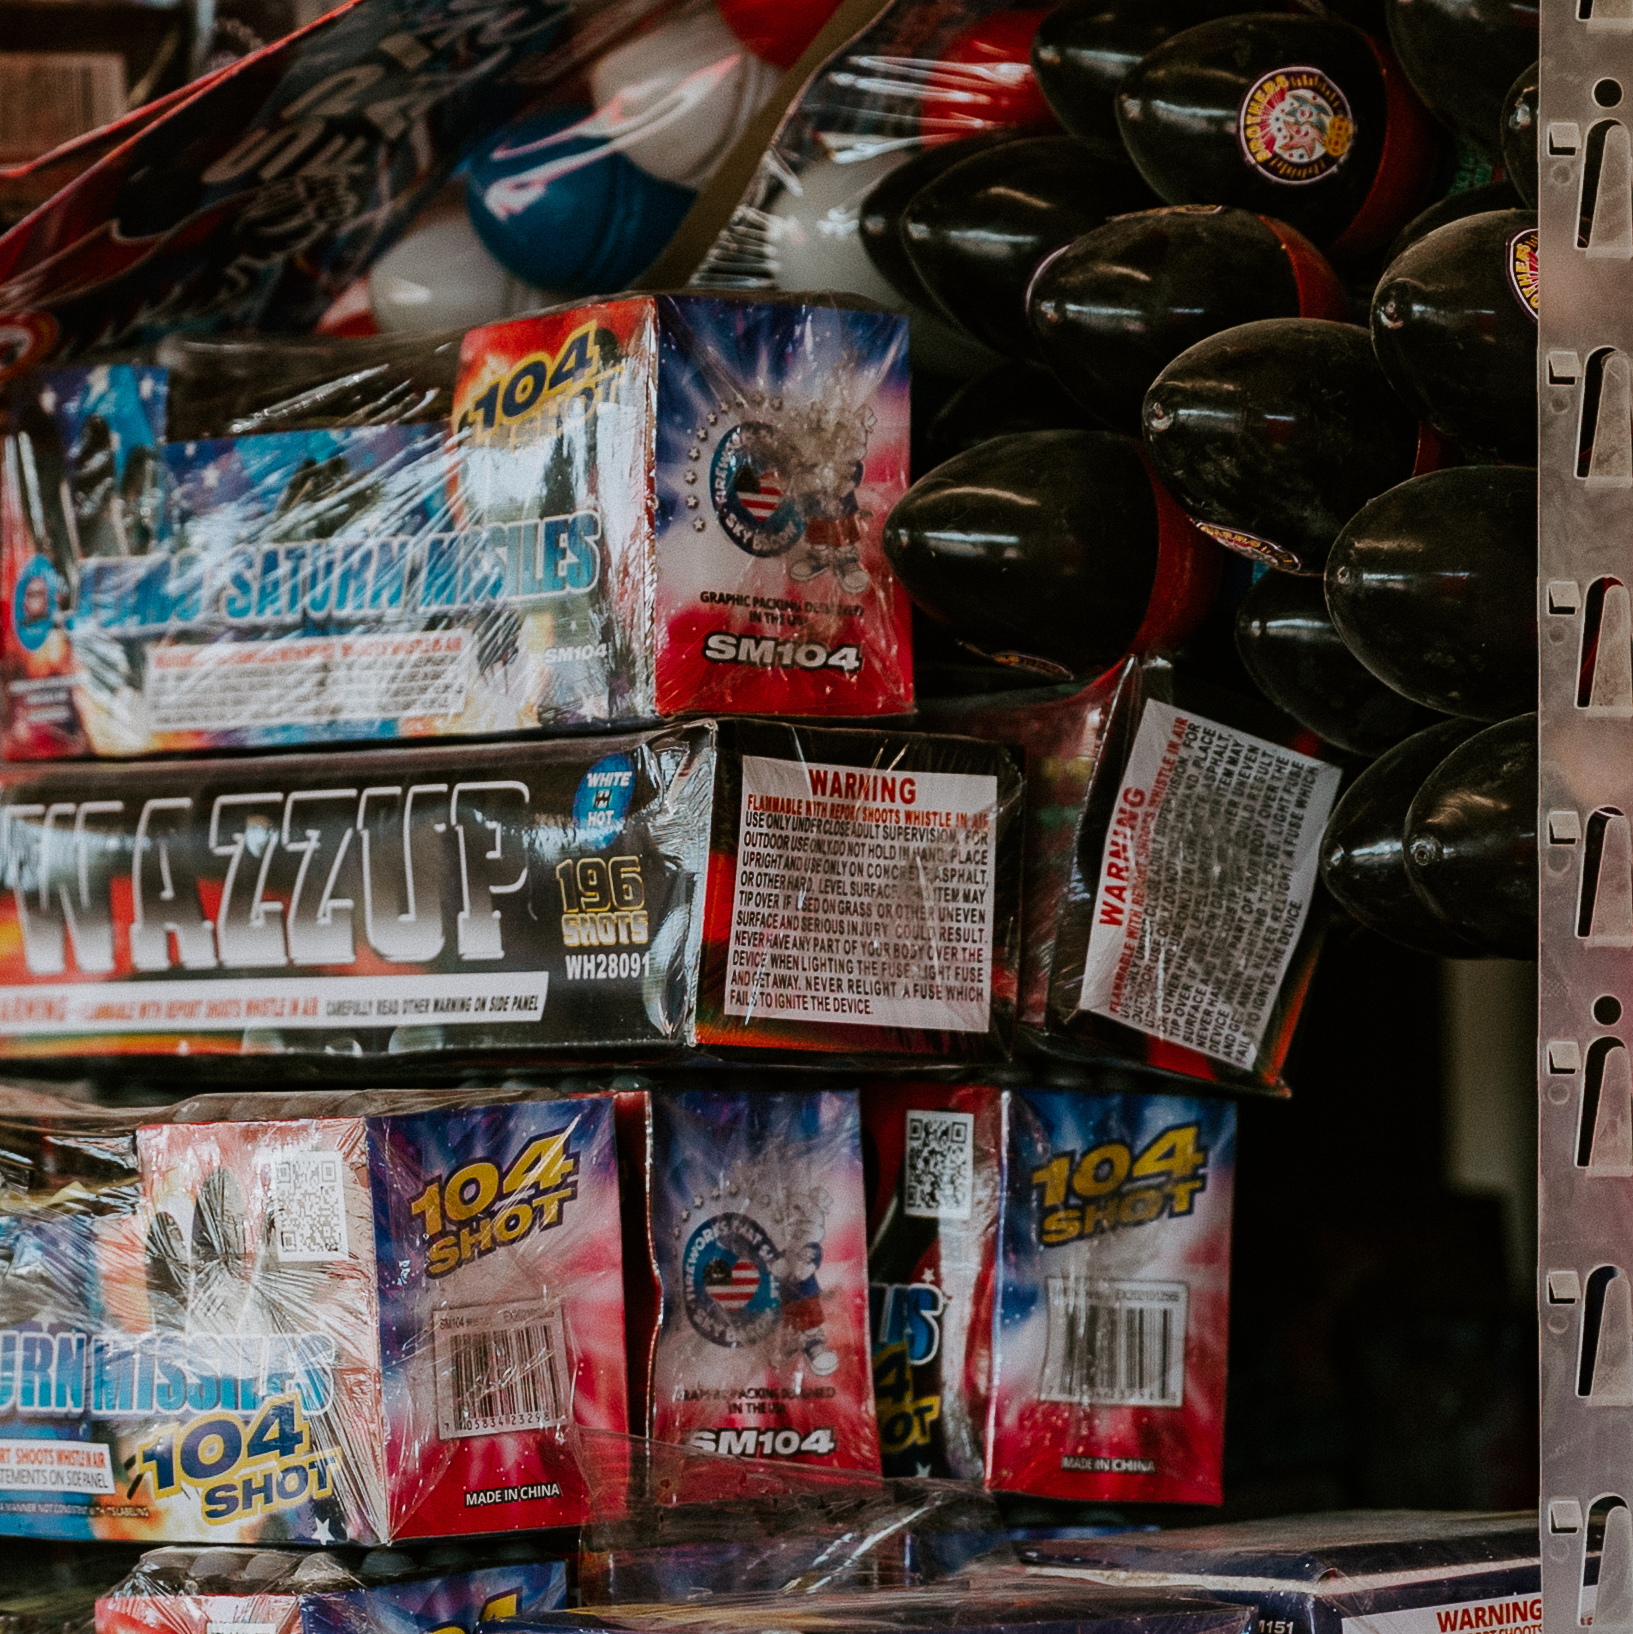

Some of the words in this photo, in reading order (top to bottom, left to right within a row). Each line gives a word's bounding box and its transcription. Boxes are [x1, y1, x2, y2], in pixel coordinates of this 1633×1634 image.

[470, 321, 600, 438] 104
[704, 634, 862, 673] SM104
[587, 771, 632, 787] WHITE
[809, 769, 916, 804] WARNING
[588, 811, 614, 825] HOT
[0, 780, 531, 975] WAZZUP
[1099, 785, 1147, 926] WARNING
[556, 856, 645, 913] 196
[561, 910, 648, 946] SHOTS
[810, 996, 830, 1012] THE
[412, 1132, 581, 1236] 104
[1032, 1124, 1208, 1209] 104
[427, 1188, 577, 1279] SHOT
[1040, 1175, 1208, 1249] SHOT
[140, 1395, 312, 1501] 104
[689, 1428, 836, 1455] SM104
[202, 1449, 341, 1524] SHOT
[466, 1490, 501, 1506] MADE
[504, 1488, 518, 1501] IN
[520, 1483, 560, 1499] CHINA
[1437, 1599, 1542, 1633] WARNING
